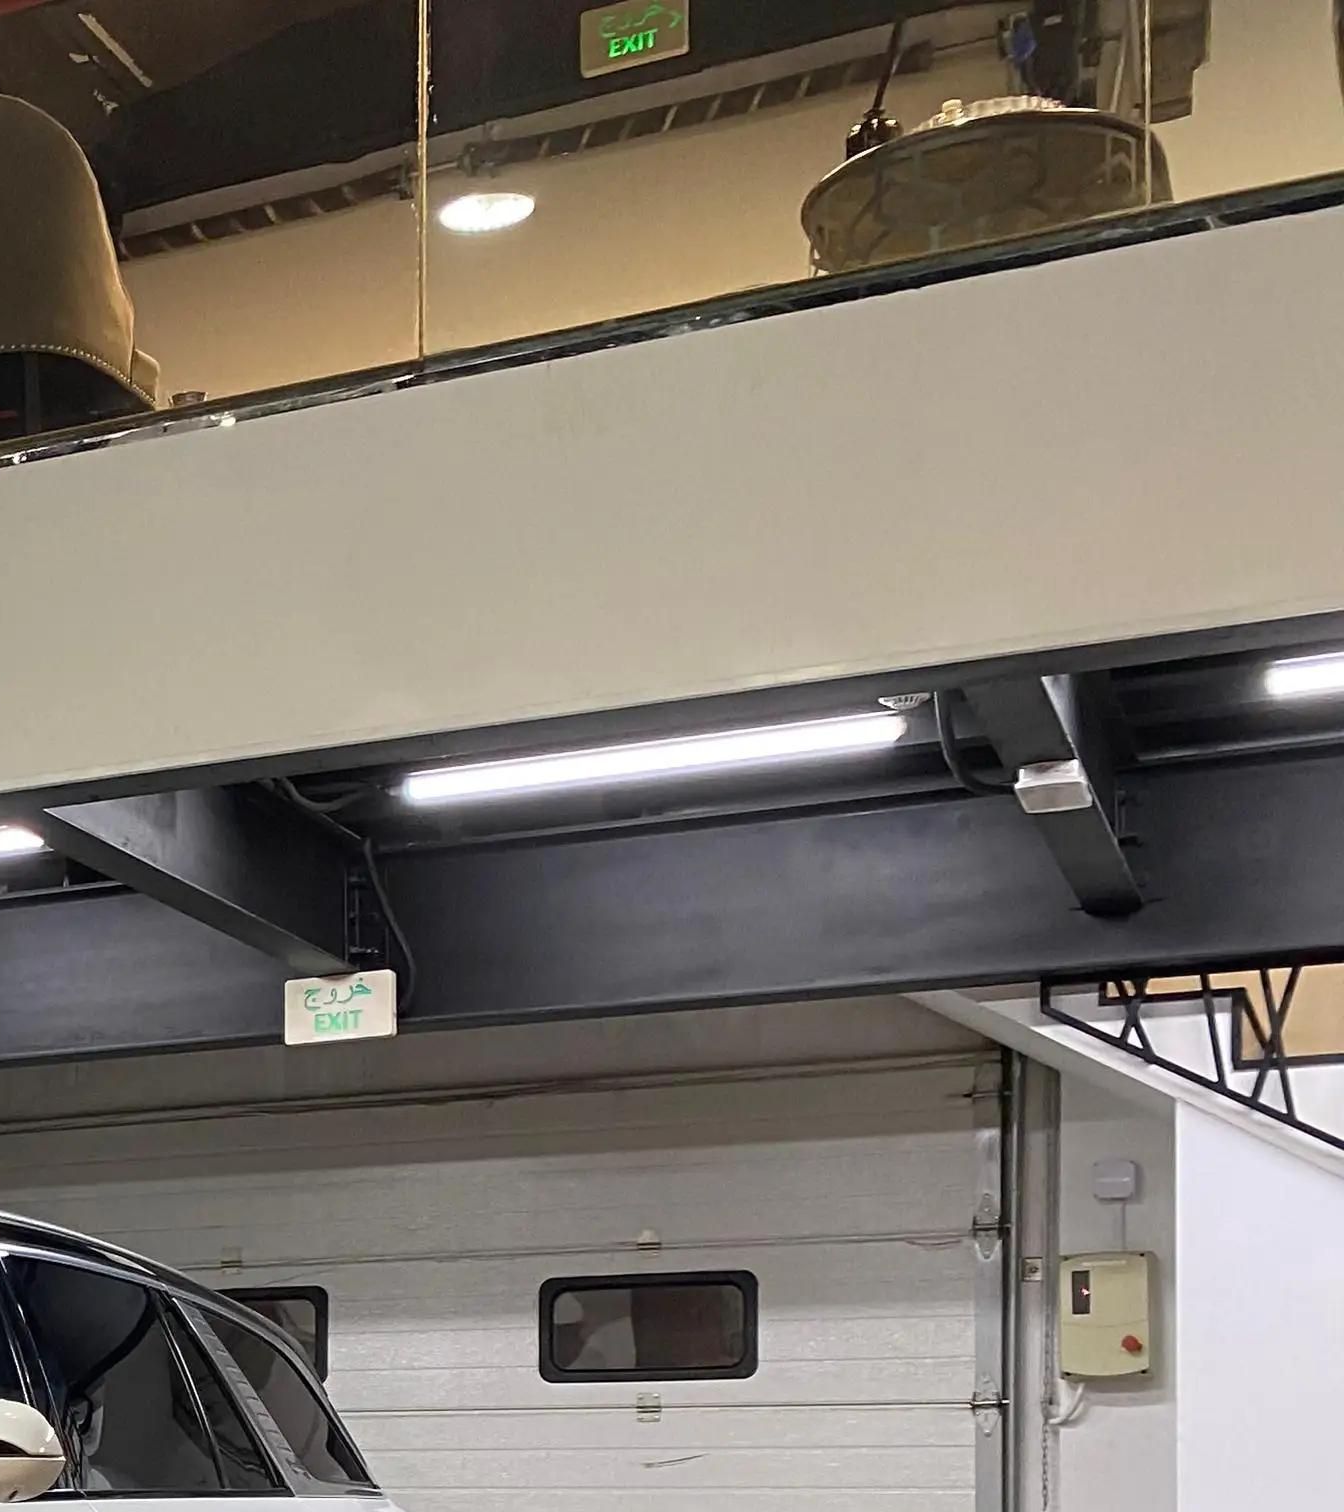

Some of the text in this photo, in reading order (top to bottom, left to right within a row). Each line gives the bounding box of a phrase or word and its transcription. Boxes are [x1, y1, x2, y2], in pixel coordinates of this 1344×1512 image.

[608, 28, 659, 58] EXIT
[305, 977, 372, 1010] خروج
[315, 1010, 362, 1032] EXIT
